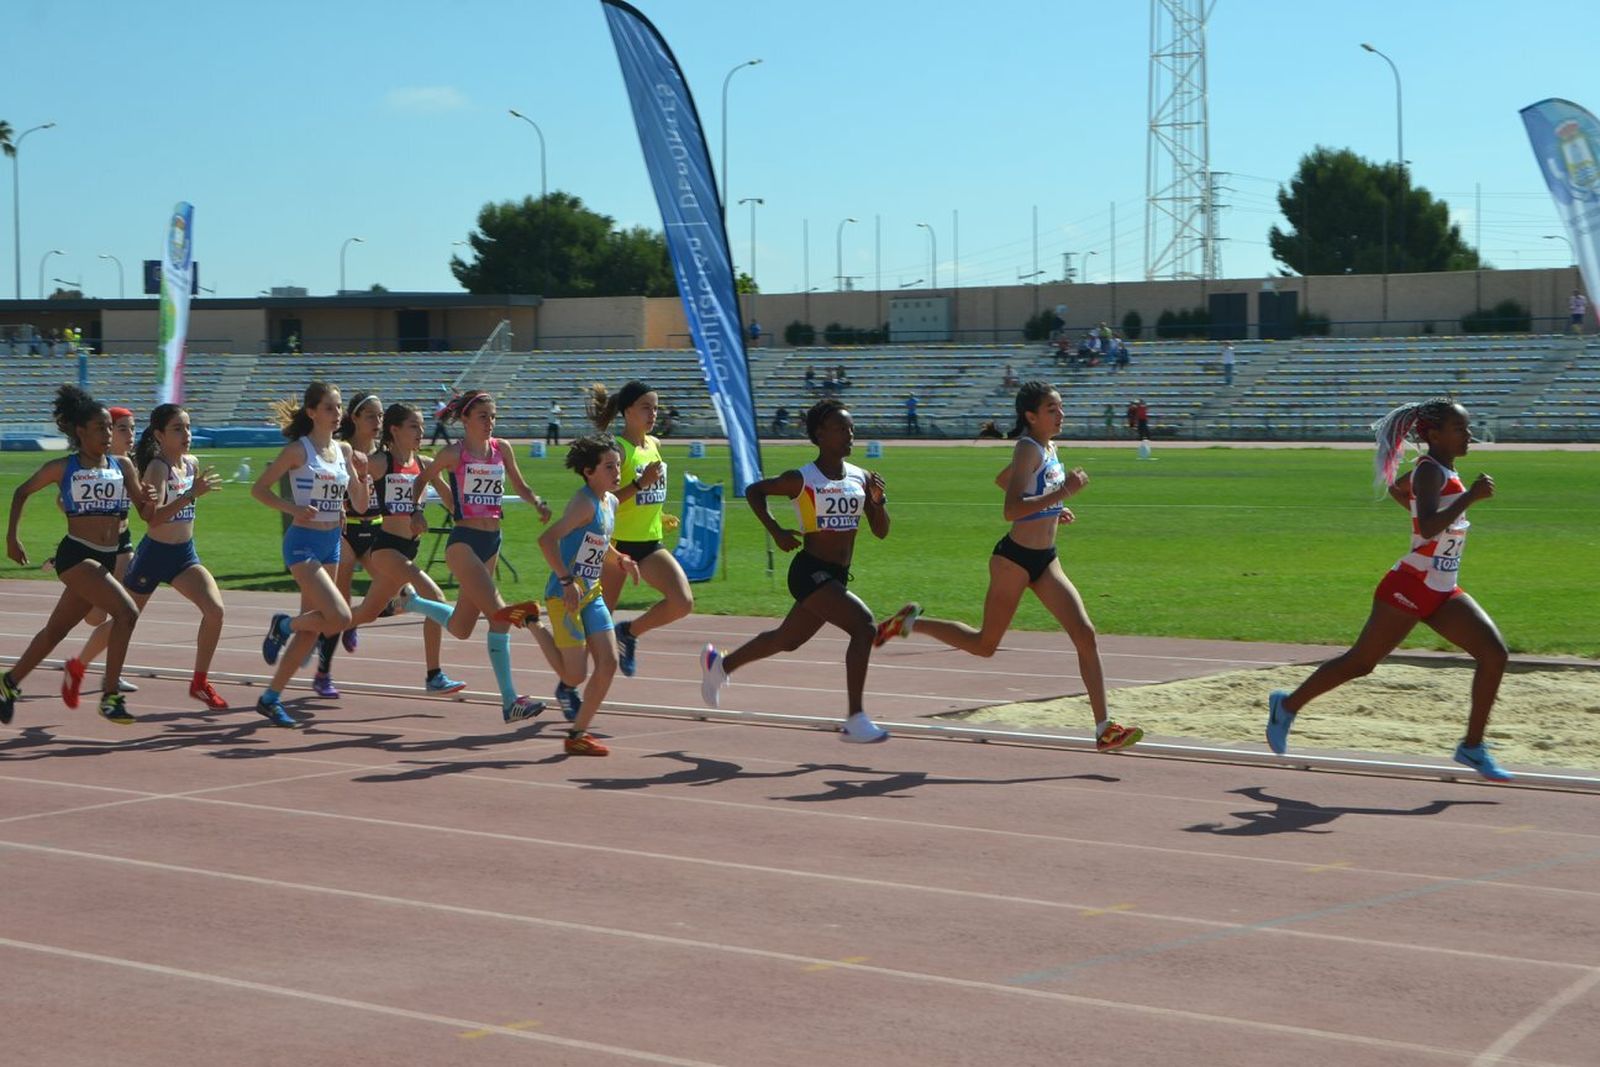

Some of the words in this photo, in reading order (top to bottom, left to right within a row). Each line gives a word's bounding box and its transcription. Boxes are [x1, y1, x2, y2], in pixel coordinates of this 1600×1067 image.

[80, 482, 115, 500] 260
[472, 478, 503, 495] 278
[825, 497, 858, 514] 209
[583, 548, 604, 565] 28
